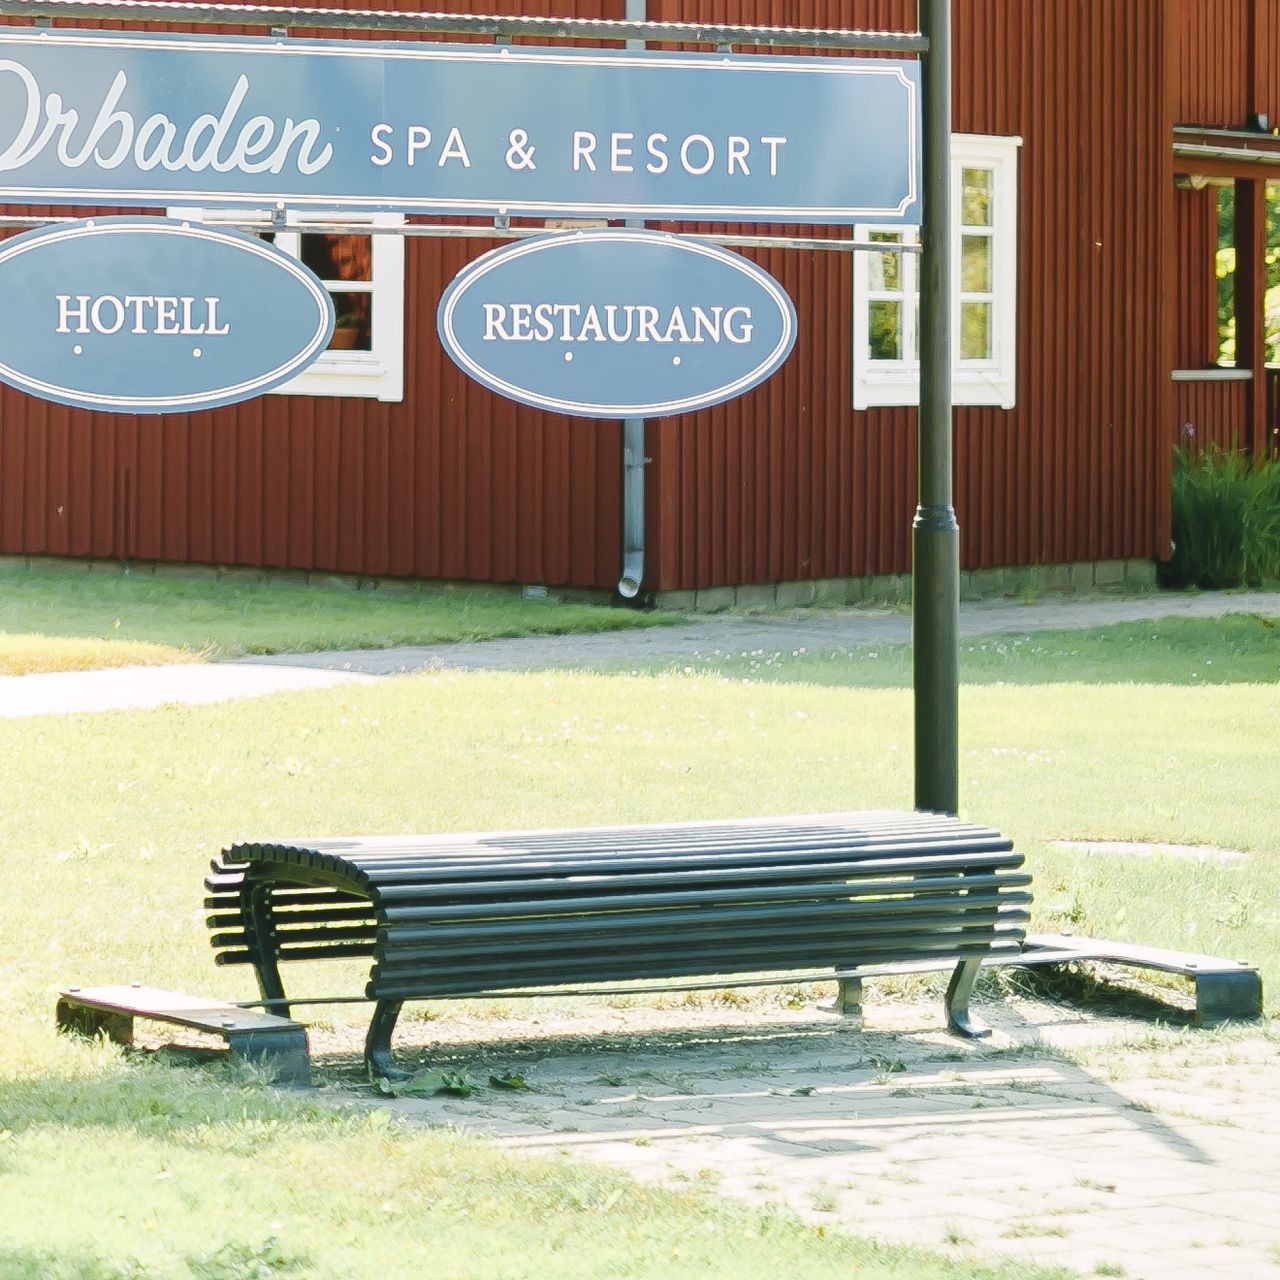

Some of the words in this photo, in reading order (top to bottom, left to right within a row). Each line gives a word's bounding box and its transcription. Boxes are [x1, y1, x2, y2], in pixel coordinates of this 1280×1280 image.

[369, 123, 472, 169] SPA
[504, 128, 538, 171] &
[572, 131, 788, 177] RESORT
[55, 294, 230, 335] HOTELL
[482, 303, 754, 344] RESTAURANG
